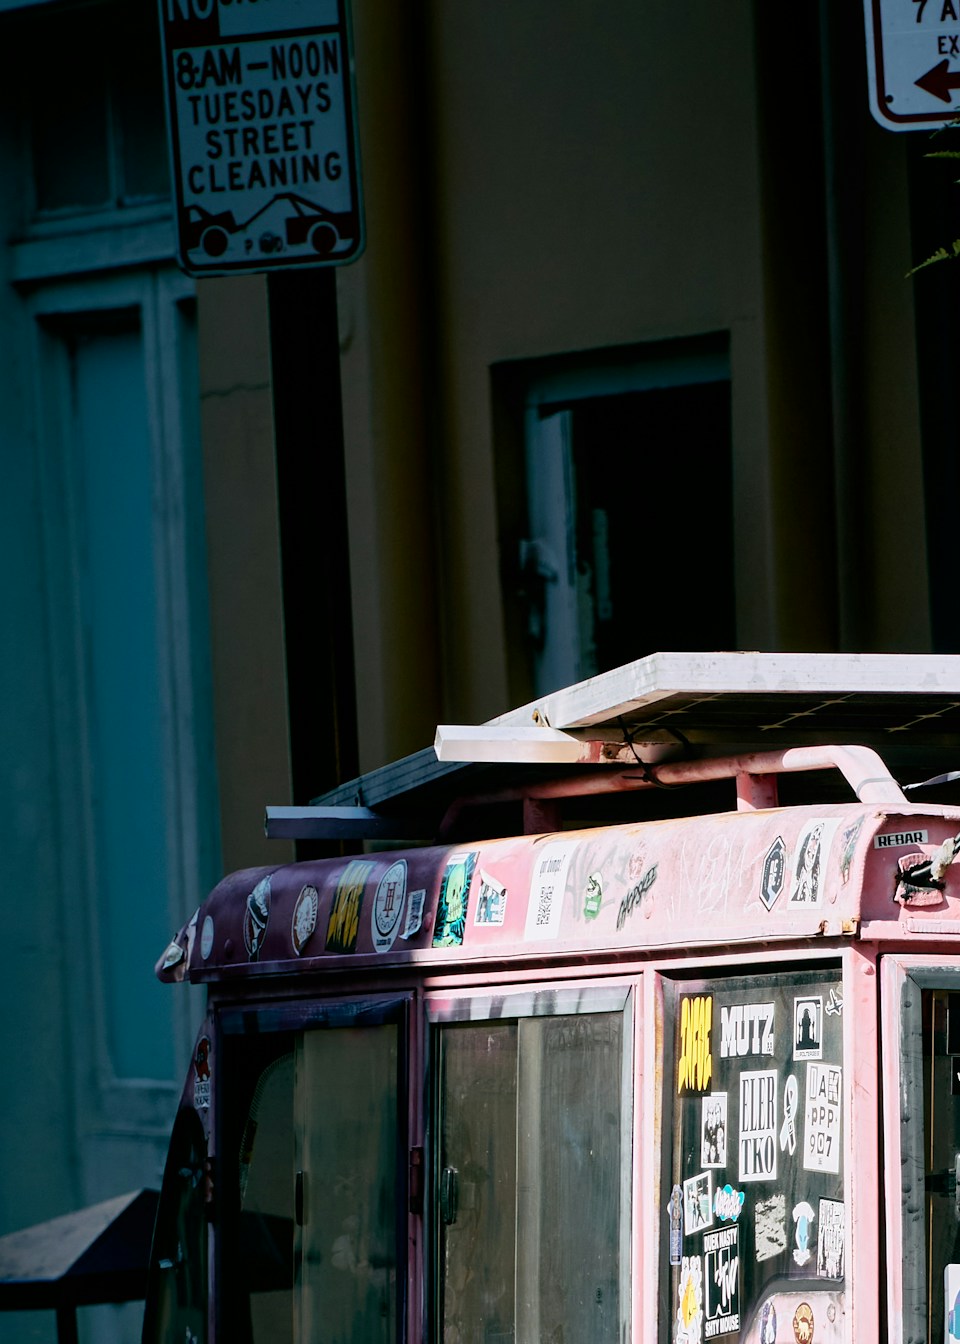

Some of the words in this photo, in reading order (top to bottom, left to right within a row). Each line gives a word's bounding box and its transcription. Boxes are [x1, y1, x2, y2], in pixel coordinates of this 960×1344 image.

[188, 82, 331, 125] TUESDAYS
[206, 121, 314, 159] STREET
[188, 152, 342, 194] CLEANING
[877, 832, 923, 847] REBAR
[721, 1002, 775, 1058] MUTZ
[741, 1076, 775, 1133] ELER
